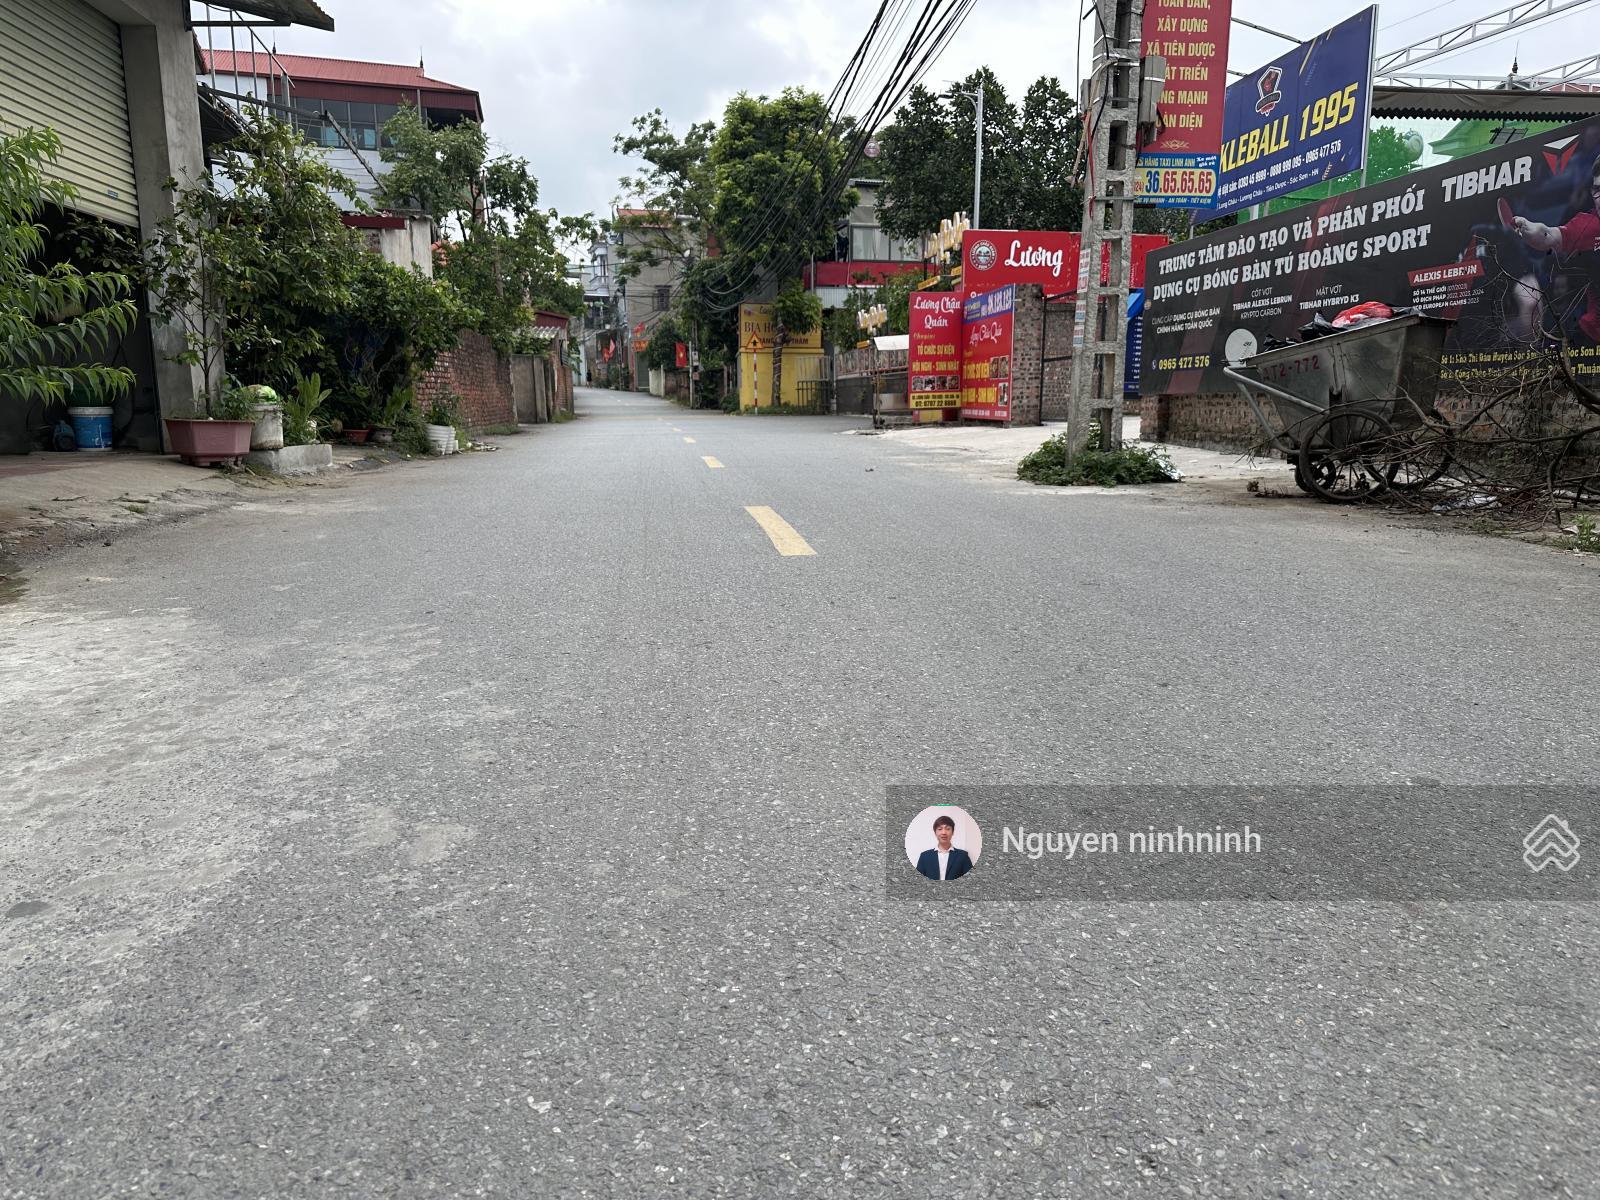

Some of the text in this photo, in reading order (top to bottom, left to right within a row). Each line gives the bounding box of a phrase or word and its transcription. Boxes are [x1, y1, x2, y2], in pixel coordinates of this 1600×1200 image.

[1157, 15, 1208, 35] XÂY DỰNG
[1146, 39, 1215, 60] XÃ TIÊN DƯỢC
[1165, 62, 1208, 80] ÁT TRIỂN
[1160, 90, 1208, 107] NG MẠNH
[1180, 112, 1203, 131] DIỆN
[1220, 82, 1359, 173] KLEBALL 1995
[1145, 170, 1213, 194] 36.65.65.65
[1159, 155, 1533, 275] TRUNG TÂM ĐÀO TẠO VÀ PHÂN PHỐI TIBHAR
[1004, 240, 1064, 277] Lương
[1153, 224, 1432, 302] DỤNG CỤ BÓNG BÀN TÚ HOÀNG SPORT
[1413, 271, 1442, 283] ALEXIS
[914, 296, 940, 313] Lương
[940, 296, 961, 314] Châu
[1300, 299, 1322, 310] TIBHAR
[924, 314, 948, 330] Quán
[1158, 355, 1210, 370] 0965 477 576
